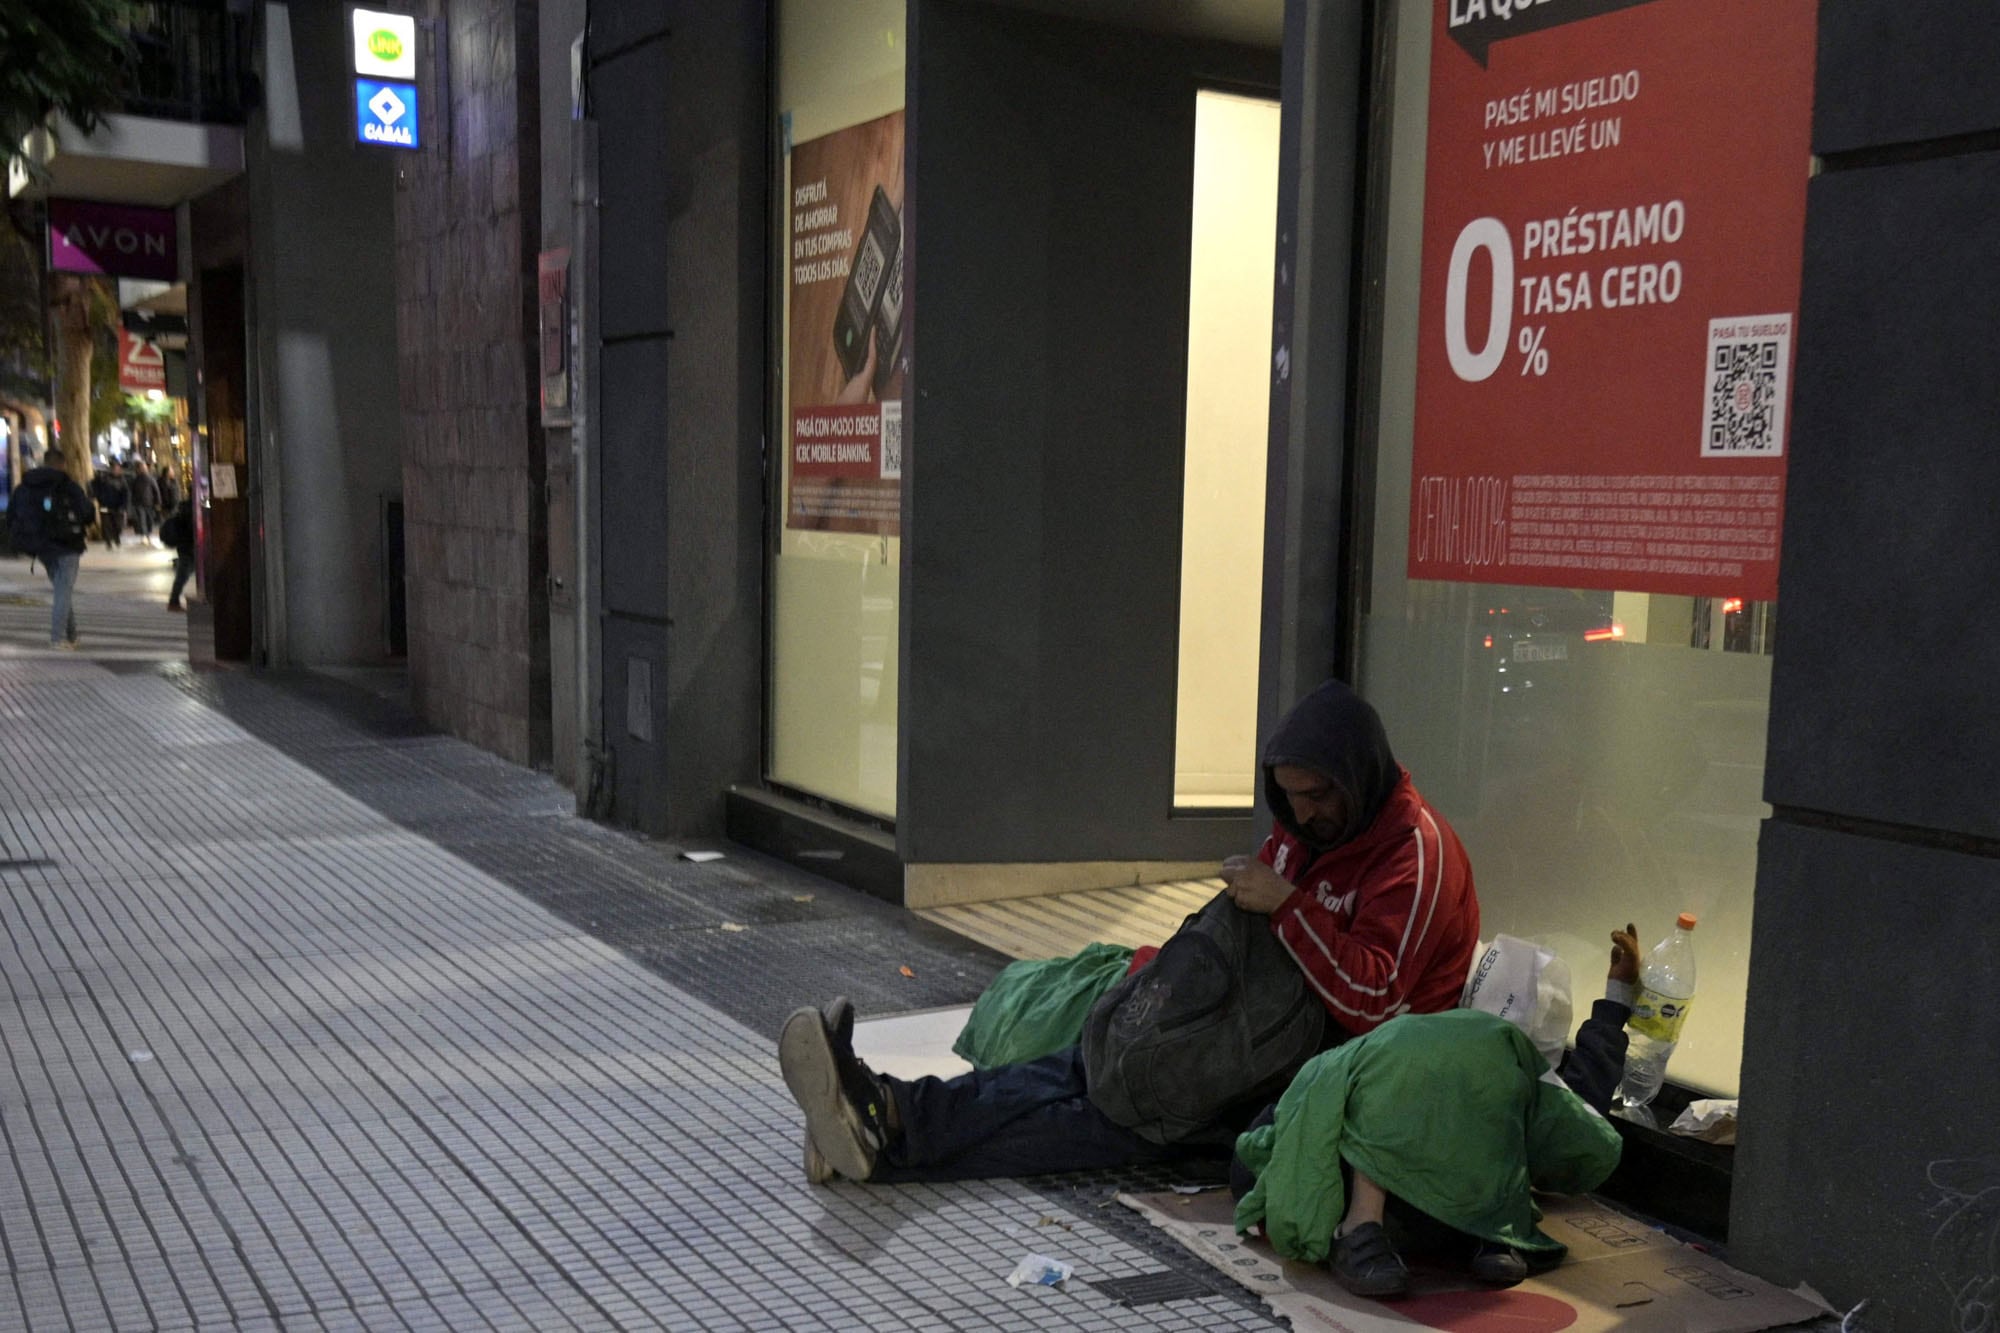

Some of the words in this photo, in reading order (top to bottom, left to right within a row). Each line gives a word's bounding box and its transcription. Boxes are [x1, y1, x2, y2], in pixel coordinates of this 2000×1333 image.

[1449, 0, 1488, 28] LA
[1484, 88, 1531, 130] PASÉ
[1534, 88, 1559, 120] MI
[1560, 69, 1640, 115] SUELDO
[1483, 142, 1496, 170] Y
[1497, 135, 1526, 167] ME
[1528, 118, 1587, 162] LLEVÉ
[1591, 117, 1622, 151] UN
[795, 176, 828, 207] DISFRUTÁ
[795, 213, 804, 233] DE
[804, 205, 838, 231] AHORRAR
[1523, 199, 1685, 260] PRÉSTAMO
[63, 224, 166, 257] AVON
[795, 239, 804, 260] EN
[804, 235, 818, 257] TUS
[818, 229, 852, 255] COMPRAS
[795, 262, 817, 285] TODOS
[817, 260, 832, 281] LOS
[1520, 271, 1593, 316] TASA
[1601, 260, 1683, 309] CERO
[1445, 216, 1515, 383] 0
[1518, 325, 1549, 377] %
[796, 414, 814, 438] PAGÁ
[815, 418, 830, 437] CON
[830, 416, 855, 437] MODO
[855, 415, 880, 436] DESDE
[796, 443, 810, 463] ICBC
[811, 443, 837, 463] MOBILE
[837, 443, 872, 463] BANKING.
